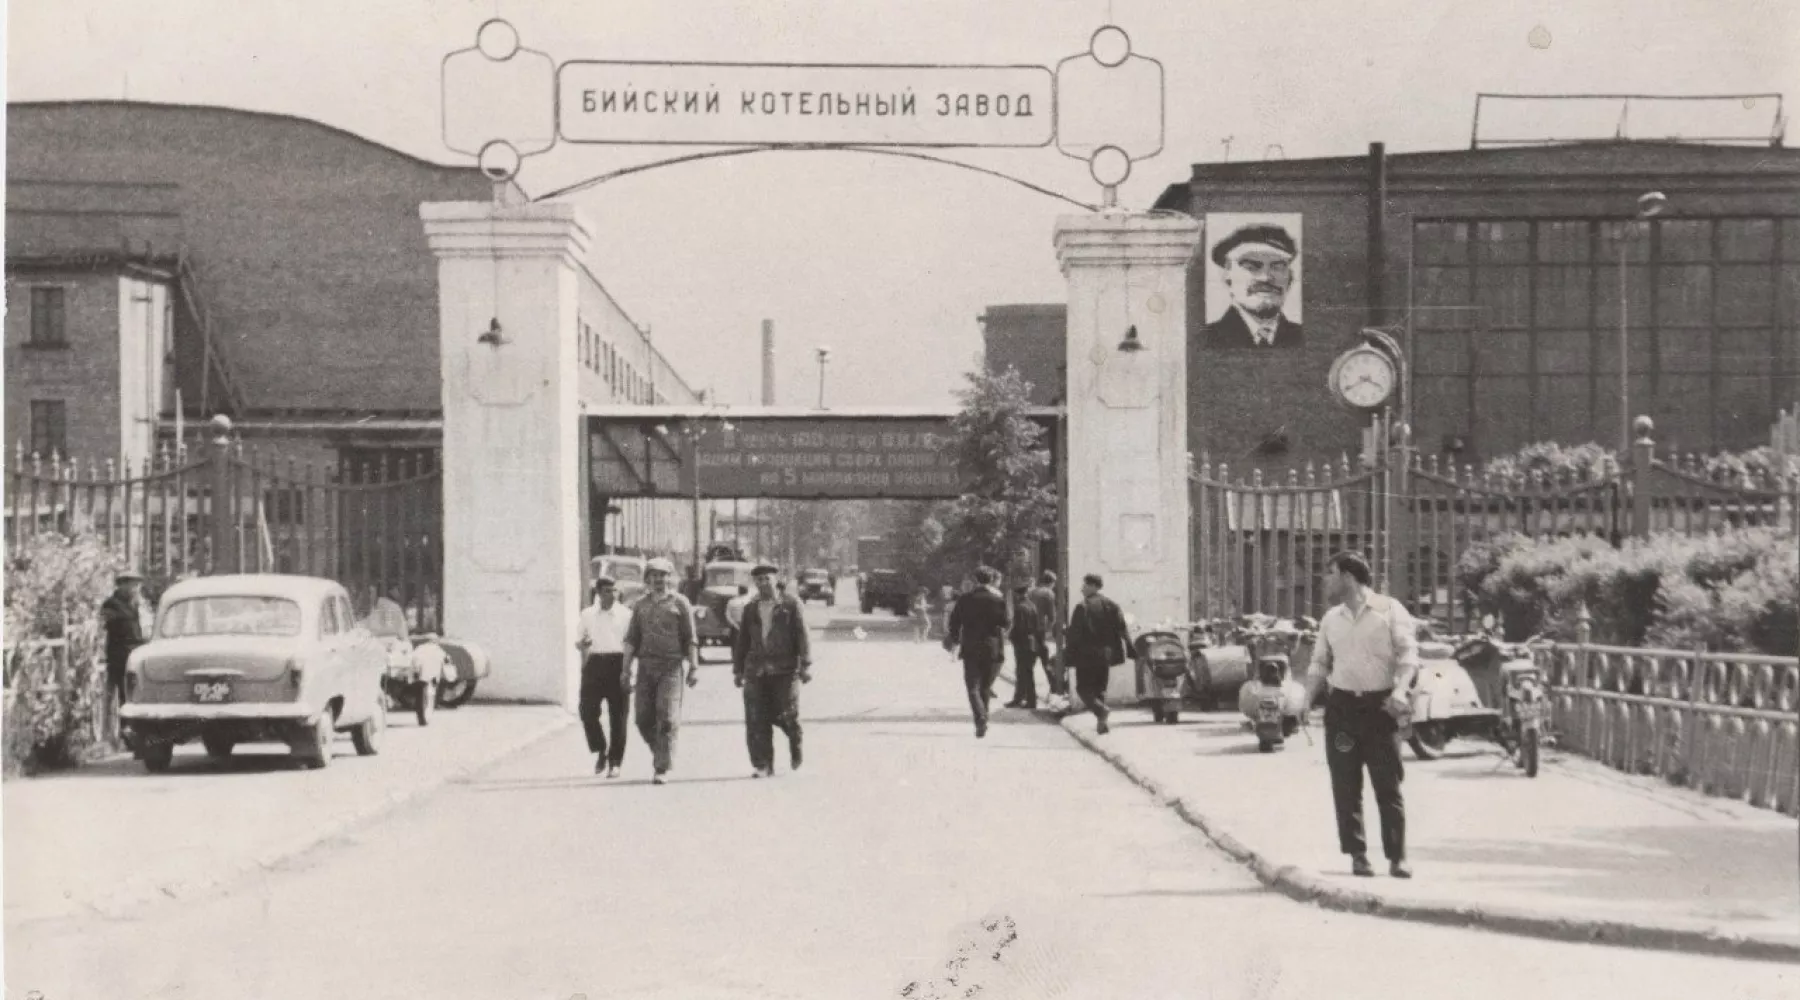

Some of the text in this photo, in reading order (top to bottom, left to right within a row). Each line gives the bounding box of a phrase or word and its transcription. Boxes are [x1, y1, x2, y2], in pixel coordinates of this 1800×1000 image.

[582, 81, 1034, 117] БИЙСКИЙ КОТЕЛЬНЫЙ ЗАВОД
[783, 467, 797, 486] 5
